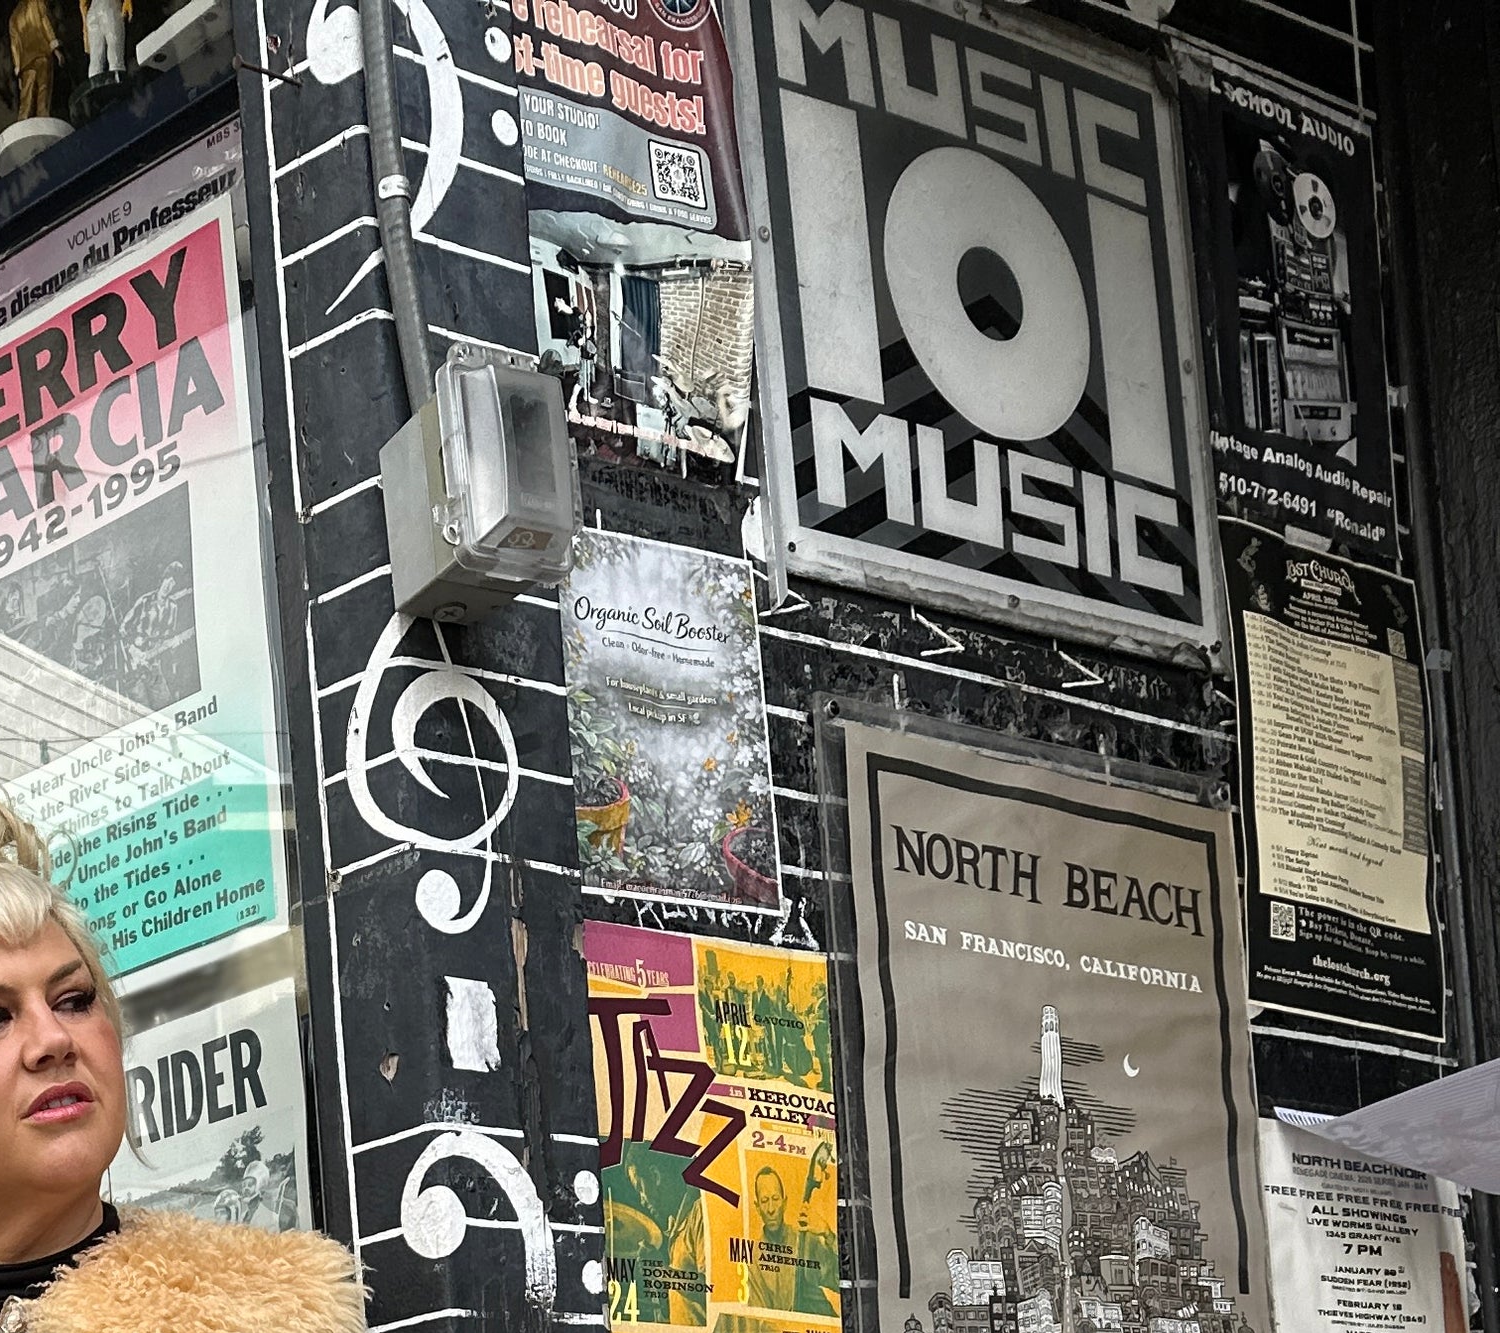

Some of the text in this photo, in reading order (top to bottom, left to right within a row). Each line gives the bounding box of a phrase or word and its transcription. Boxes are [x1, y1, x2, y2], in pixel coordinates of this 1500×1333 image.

[533, 0, 703, 84] rehearsal for
[558, 103, 600, 130] STUDIO!
[610, 70, 706, 135] guests!
[771, 0, 1148, 208] MUSIC
[1223, 83, 1355, 158] SCHOOL AUDIO
[67, 202, 131, 250] VOLUME 9
[779, 88, 1176, 490] 101
[809, 396, 1184, 596] MUSIC
[1218, 473, 1317, 519] 510-772-6491
[1263, 446, 1393, 506] Analog Audio Repair
[574, 596, 730, 645] Organic Soil Booster
[602, 637, 624, 650] Clean
[71, 696, 218, 779] Uncle John's Band
[107, 794, 199, 843] Rising Tide
[78, 806, 227, 883] Uncle John's Band
[124, 861, 170, 889] Tides
[174, 869, 222, 899] Alone
[891, 825, 1042, 904] NORTH
[1064, 861, 1205, 937] BEACH
[141, 878, 265, 937] Children Home
[905, 920, 1202, 994] SAN FRANCISCO, CALIFORNIA
[1313, 955, 1391, 986] thelostchurch.org
[751, 1104, 810, 1128] ALLEY
[1292, 1152, 1342, 1170] NORTH
[1311, 1204, 1407, 1224] ALL SHOWINGS
[606, 1258, 699, 1284] MAY DONALD
[730, 1238, 793, 1264] MAY CHRIS
[758, 1252, 821, 1271] AMBERGER
[609, 1280, 714, 1326] 24 ROBINSON
